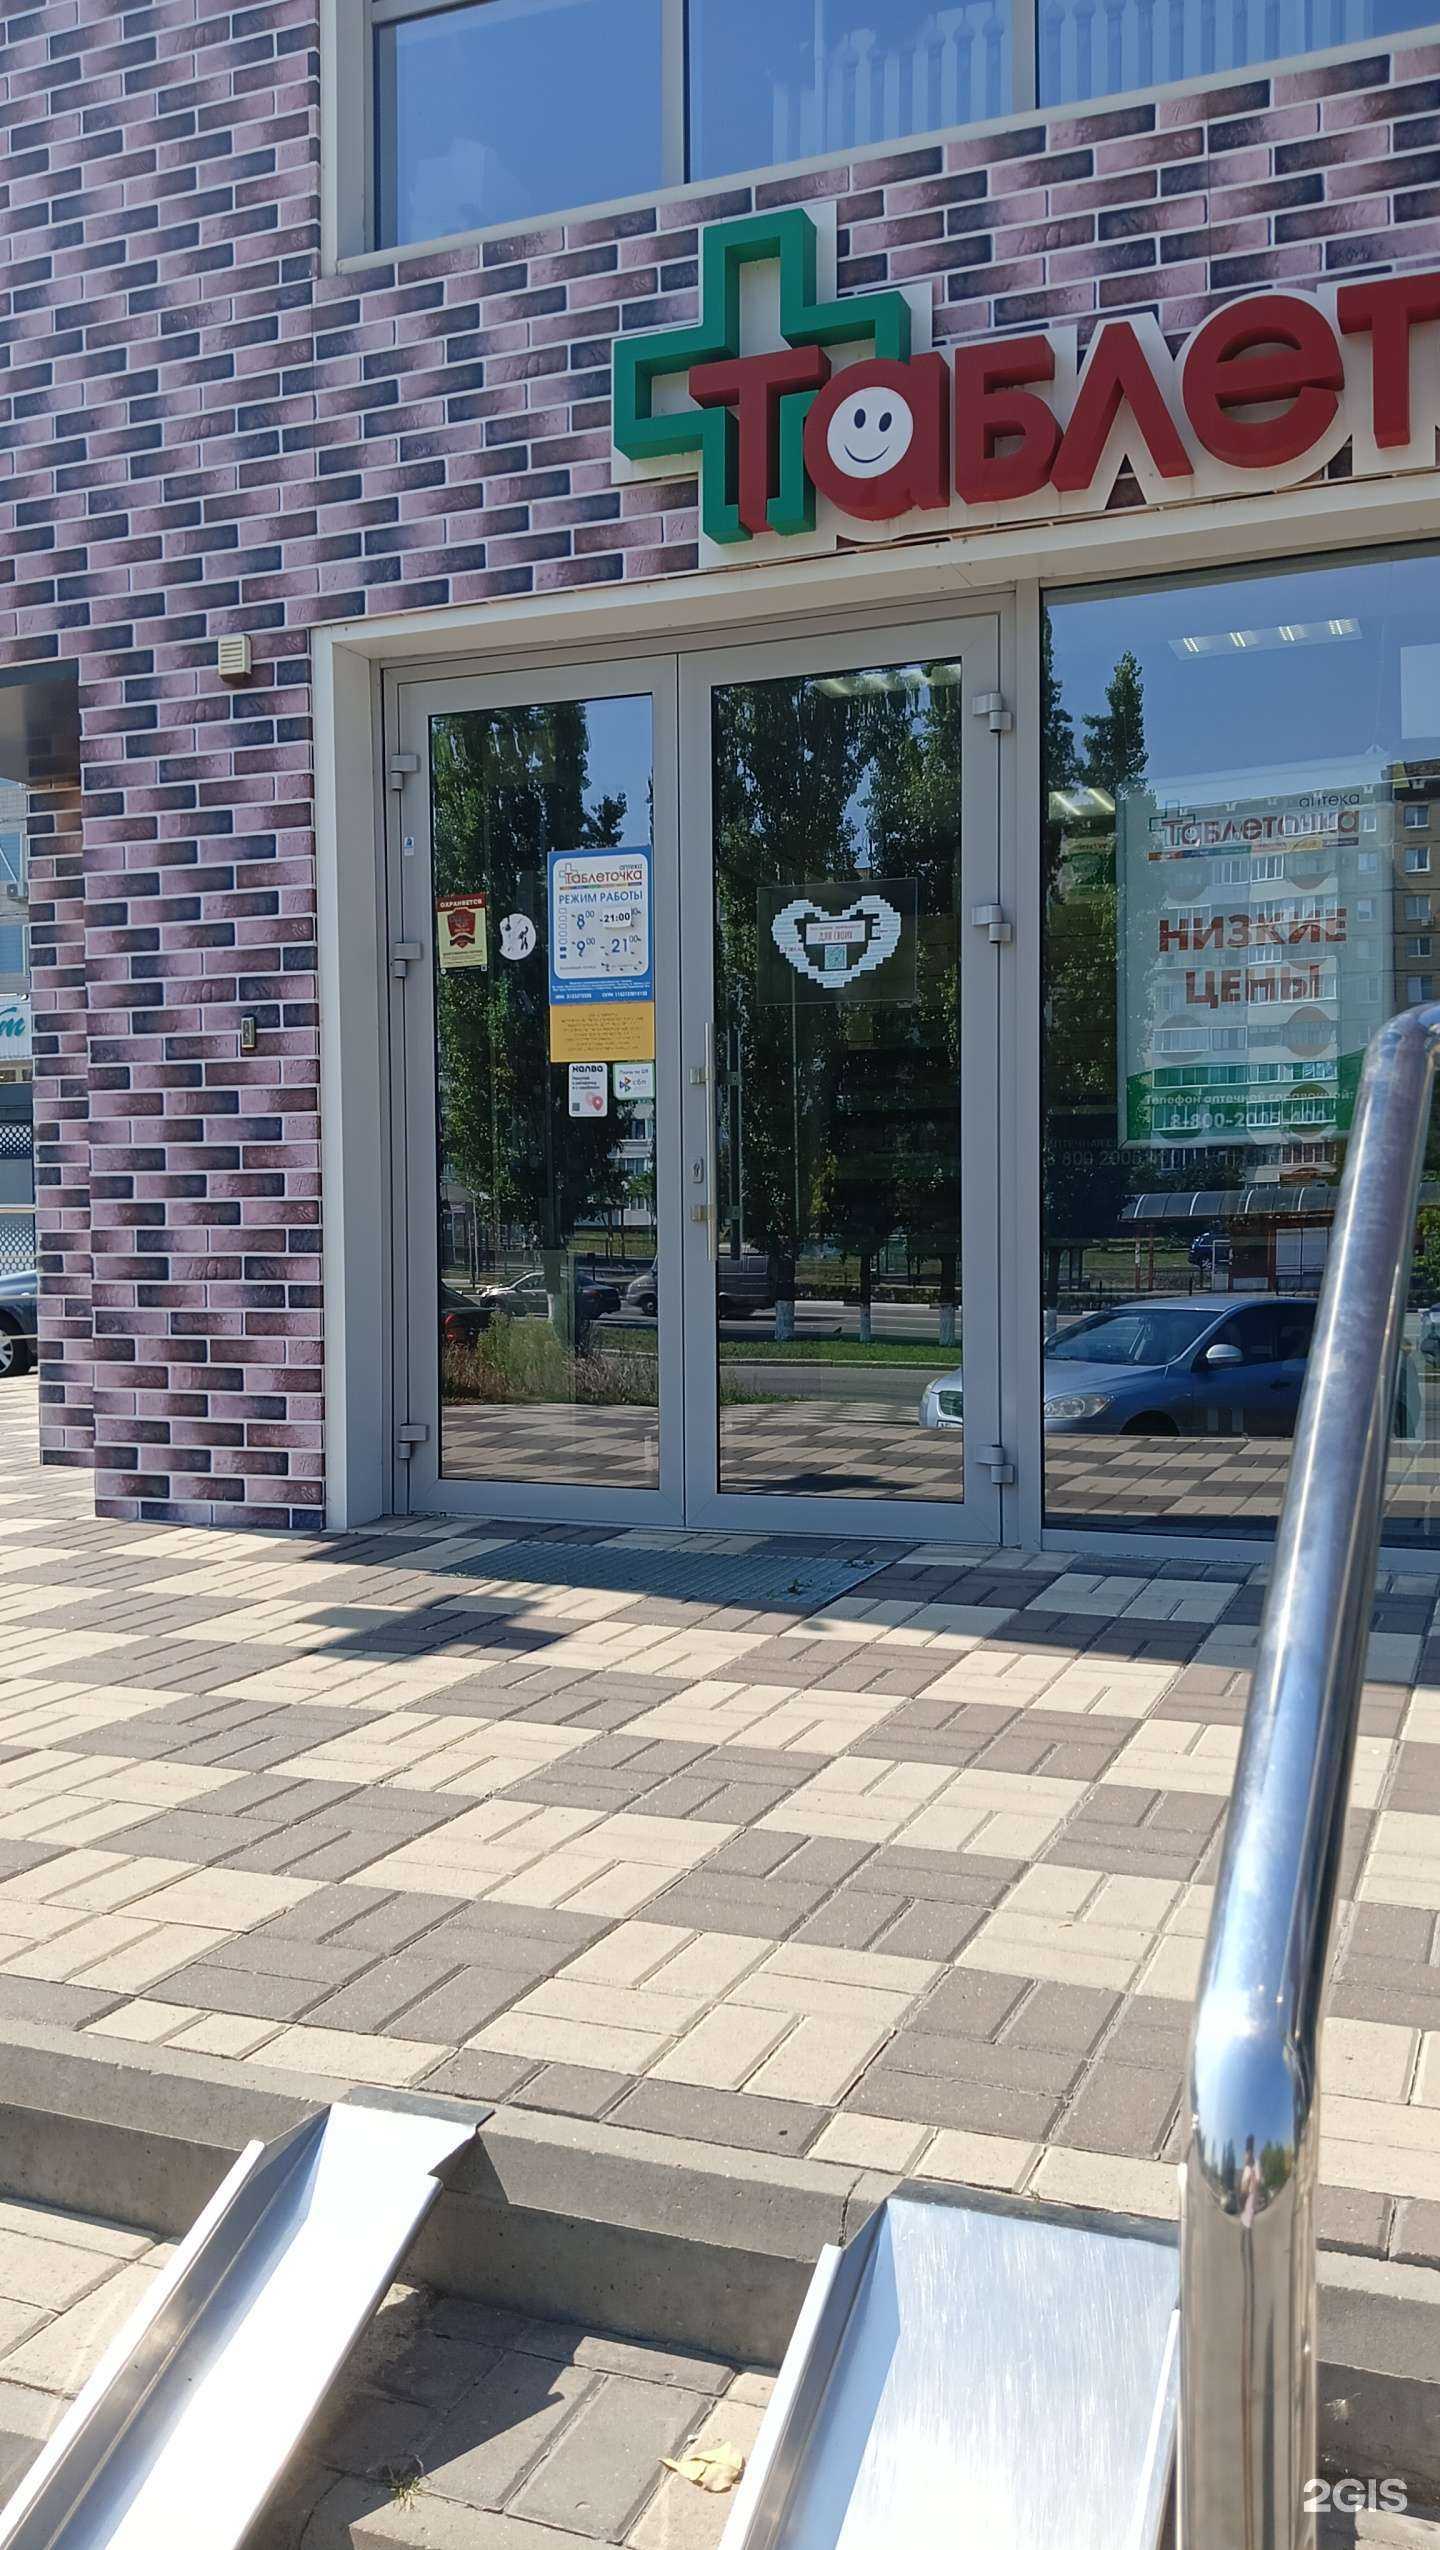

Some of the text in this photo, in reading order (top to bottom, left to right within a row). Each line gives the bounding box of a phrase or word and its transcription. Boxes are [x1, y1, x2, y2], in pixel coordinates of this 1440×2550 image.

[1299, 793, 1360, 808] аптека
[440, 898, 483, 908] ОХРАНЯЕТСЯ
[559, 890, 643, 905] РЕЖИМ РАБОТЫ
[603, 912, 631, 923] 21:00
[1158, 908, 1348, 952] НИЗКИЕ
[1185, 965, 1320, 1009] ЦЕНЫ
[1145, 1093, 1201, 1106] Телефон
